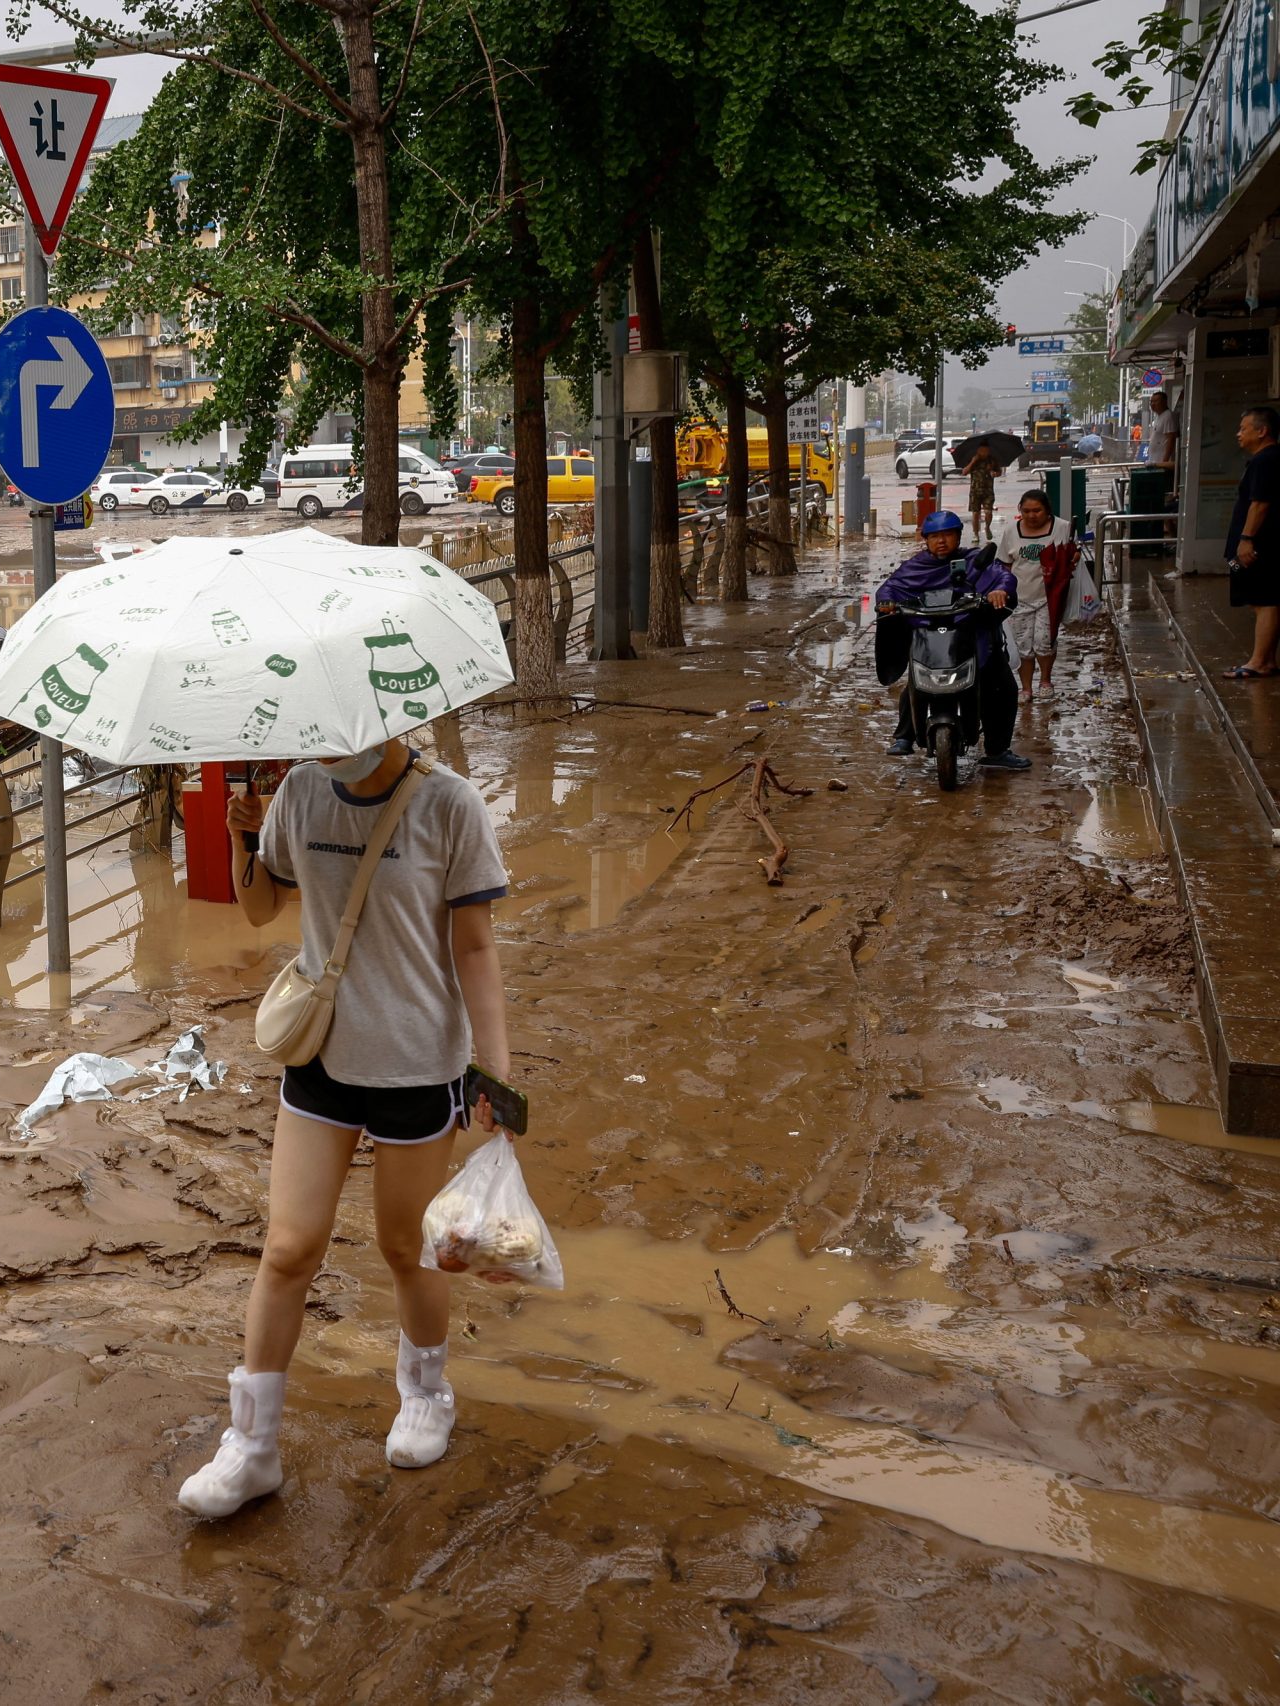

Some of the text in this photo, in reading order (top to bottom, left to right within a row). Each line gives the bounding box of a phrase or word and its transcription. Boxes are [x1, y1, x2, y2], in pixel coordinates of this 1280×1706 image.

[29, 99, 66, 161] 让
[789, 406, 817, 416] 注意右转
[790, 431, 817, 440] 货车转弯
[318, 589, 342, 613] LOVELY
[336, 597, 353, 612] MILK
[119, 607, 168, 615] LOVELY
[268, 659, 295, 671] MILK
[378, 671, 432, 692] LOVELY
[46, 674, 84, 709] LOVELY
[36, 709, 51, 722] MILK
[406, 704, 426, 713] MILK
[149, 722, 192, 743] LOVELY
[149, 736, 177, 753] MILK
